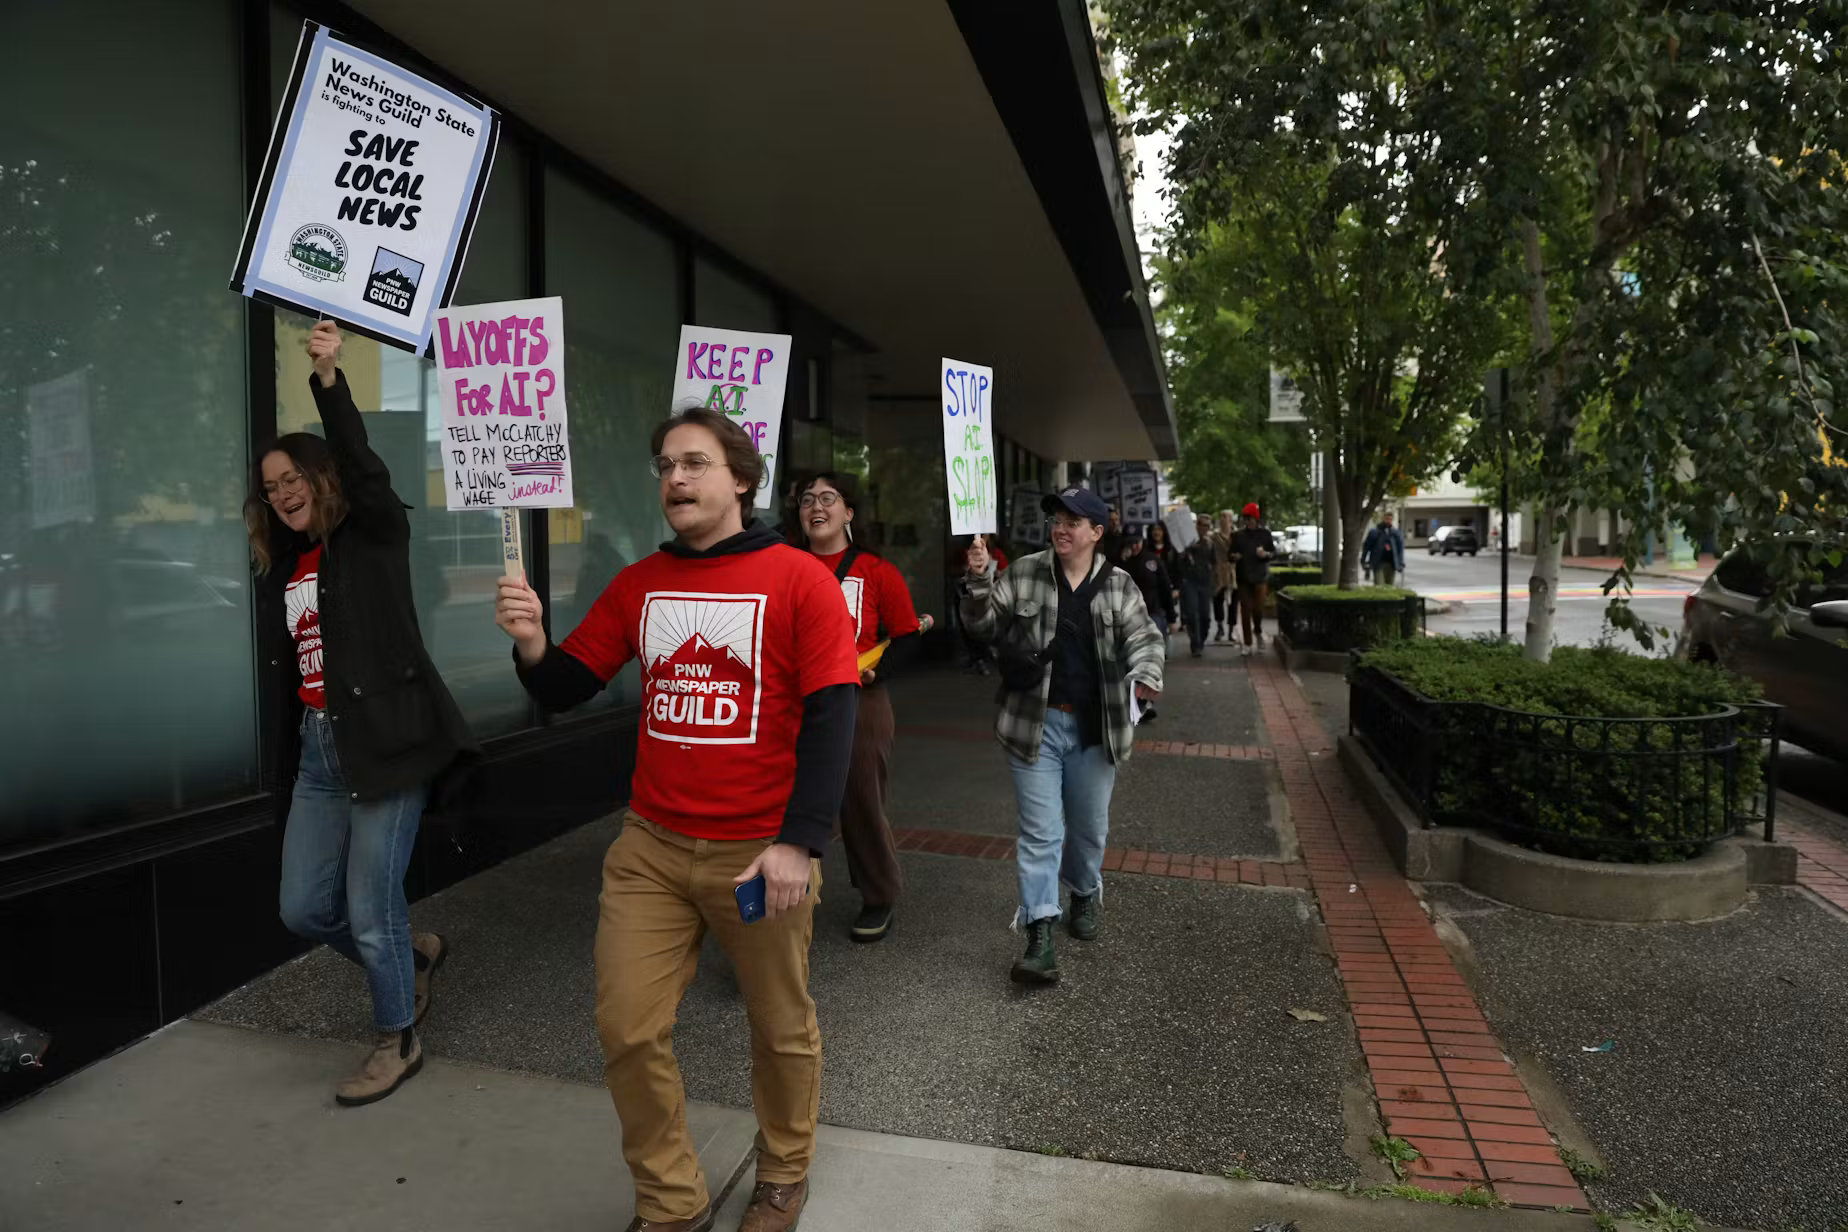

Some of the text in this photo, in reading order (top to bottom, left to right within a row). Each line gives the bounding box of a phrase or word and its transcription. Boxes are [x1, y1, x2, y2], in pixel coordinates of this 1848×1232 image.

[321, 90, 386, 125] is fighting to
[325, 74, 423, 129] News Guild
[332, 58, 475, 137] Washington State
[344, 130, 420, 167] SAVE
[334, 161, 424, 201] LOCAL
[337, 196, 422, 231] NEWS
[296, 228, 344, 257] WASHINGTON STATE
[370, 288, 408, 310] GUILD
[372, 280, 411, 299] NEWSPAPER
[386, 278, 402, 288] PNW
[437, 314, 549, 369] LAYOFFS
[687, 341, 774, 385] KEEP
[499, 368, 556, 421] AI?
[945, 367, 988, 423] STOP
[448, 424, 481, 443] TELL
[452, 450, 466, 465] TO
[472, 447, 495, 465] PAY
[455, 470, 463, 490] A
[463, 490, 496, 507] WAGE
[674, 663, 712, 678] PNW
[656, 679, 740, 696] NEWSPAPER
[653, 693, 739, 726] GUILD
